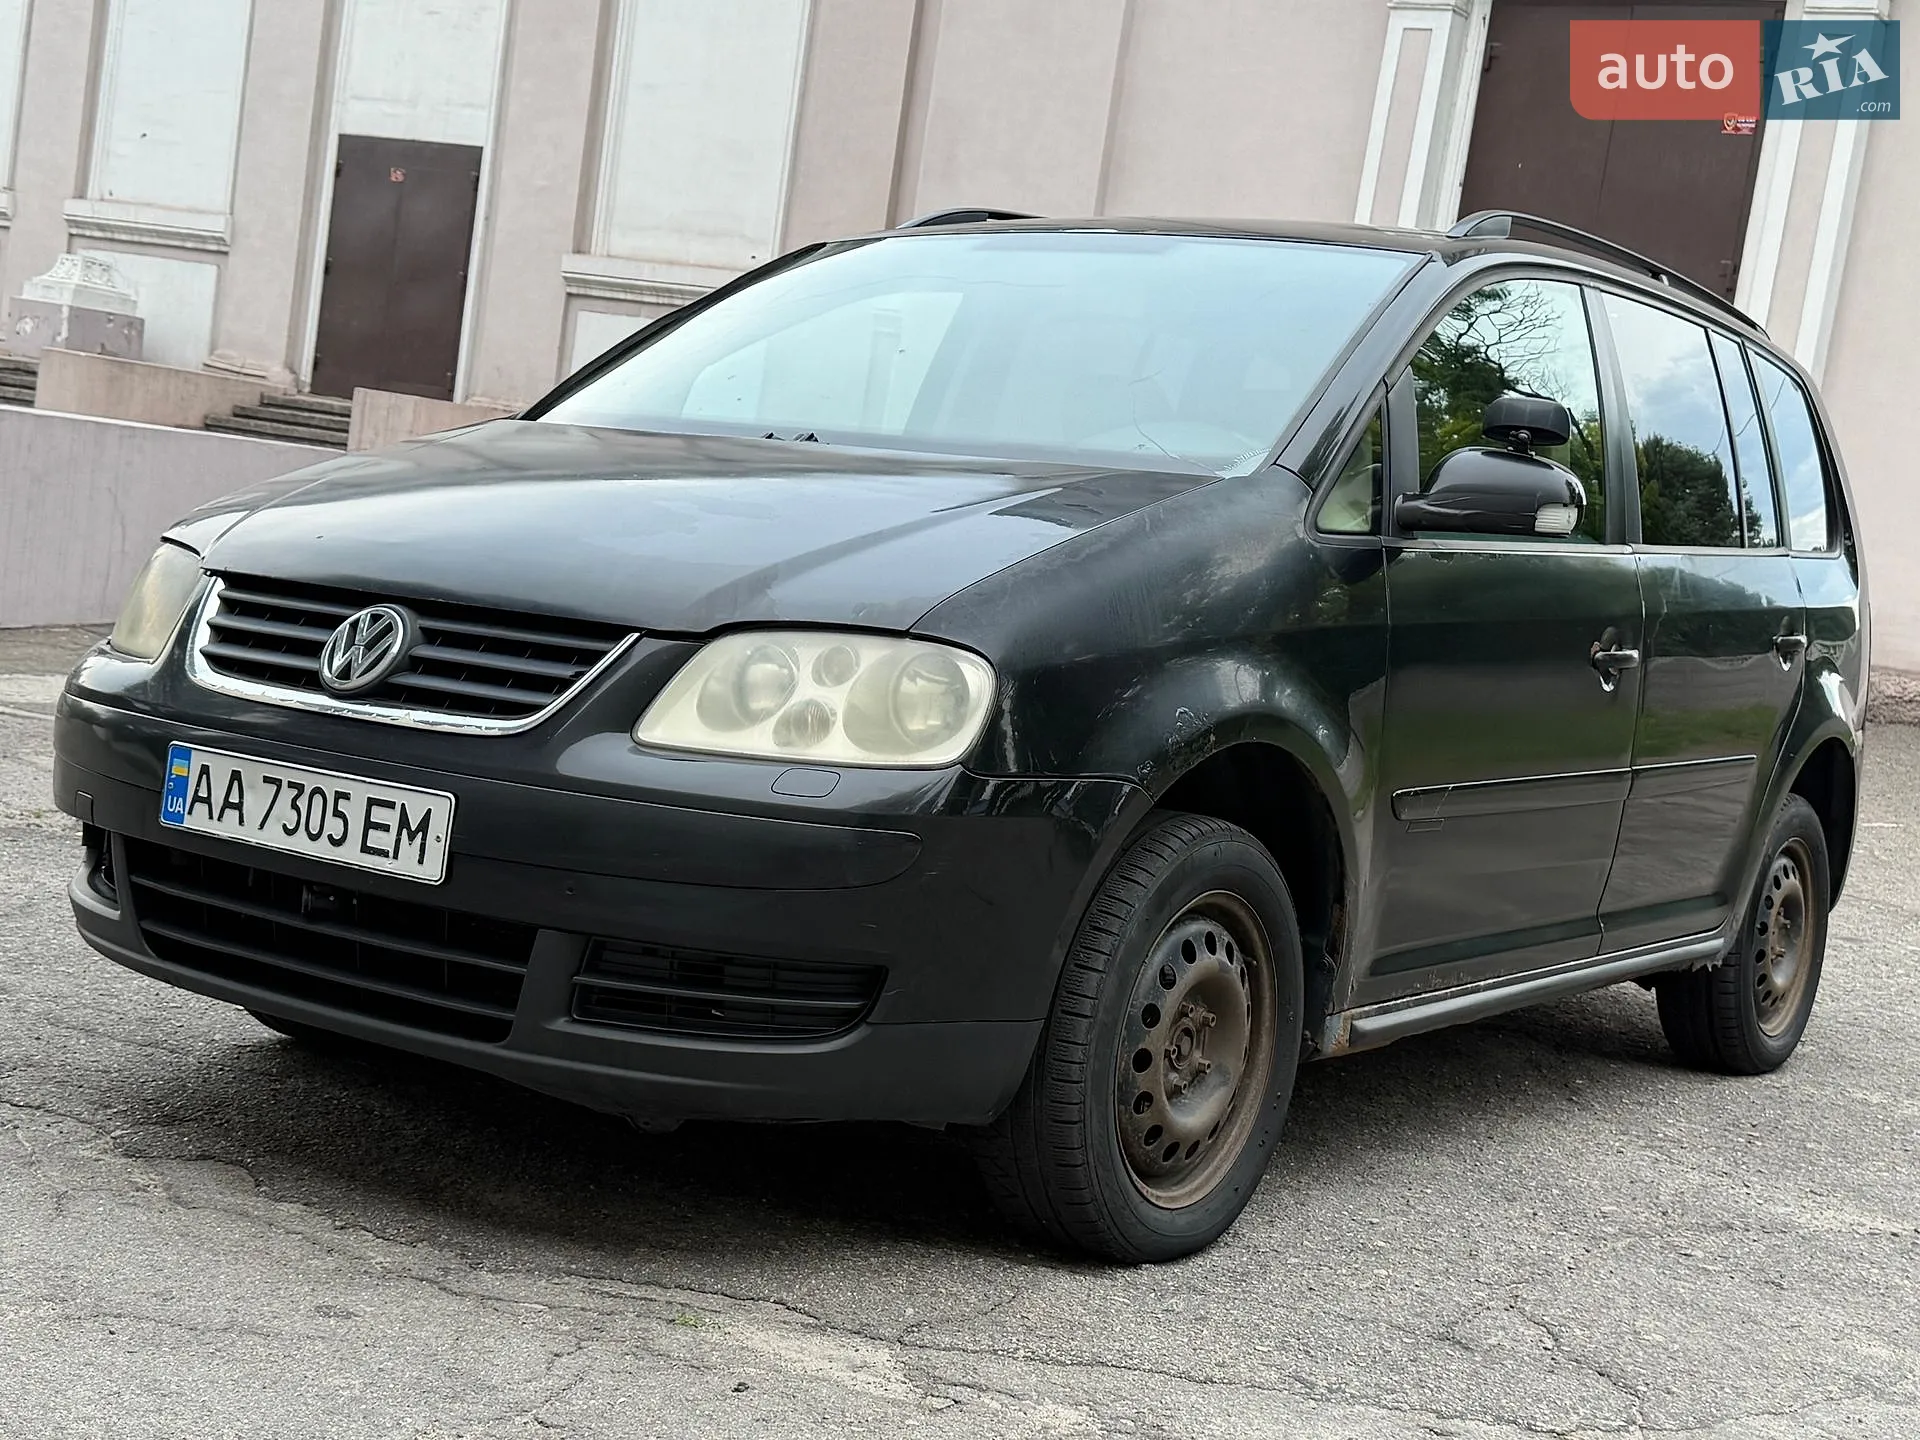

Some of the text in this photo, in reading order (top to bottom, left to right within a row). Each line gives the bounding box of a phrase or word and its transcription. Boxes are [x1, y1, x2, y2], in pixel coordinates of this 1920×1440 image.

[167, 796, 184, 814] UA
[187, 763, 432, 865] AA 7305 EM
